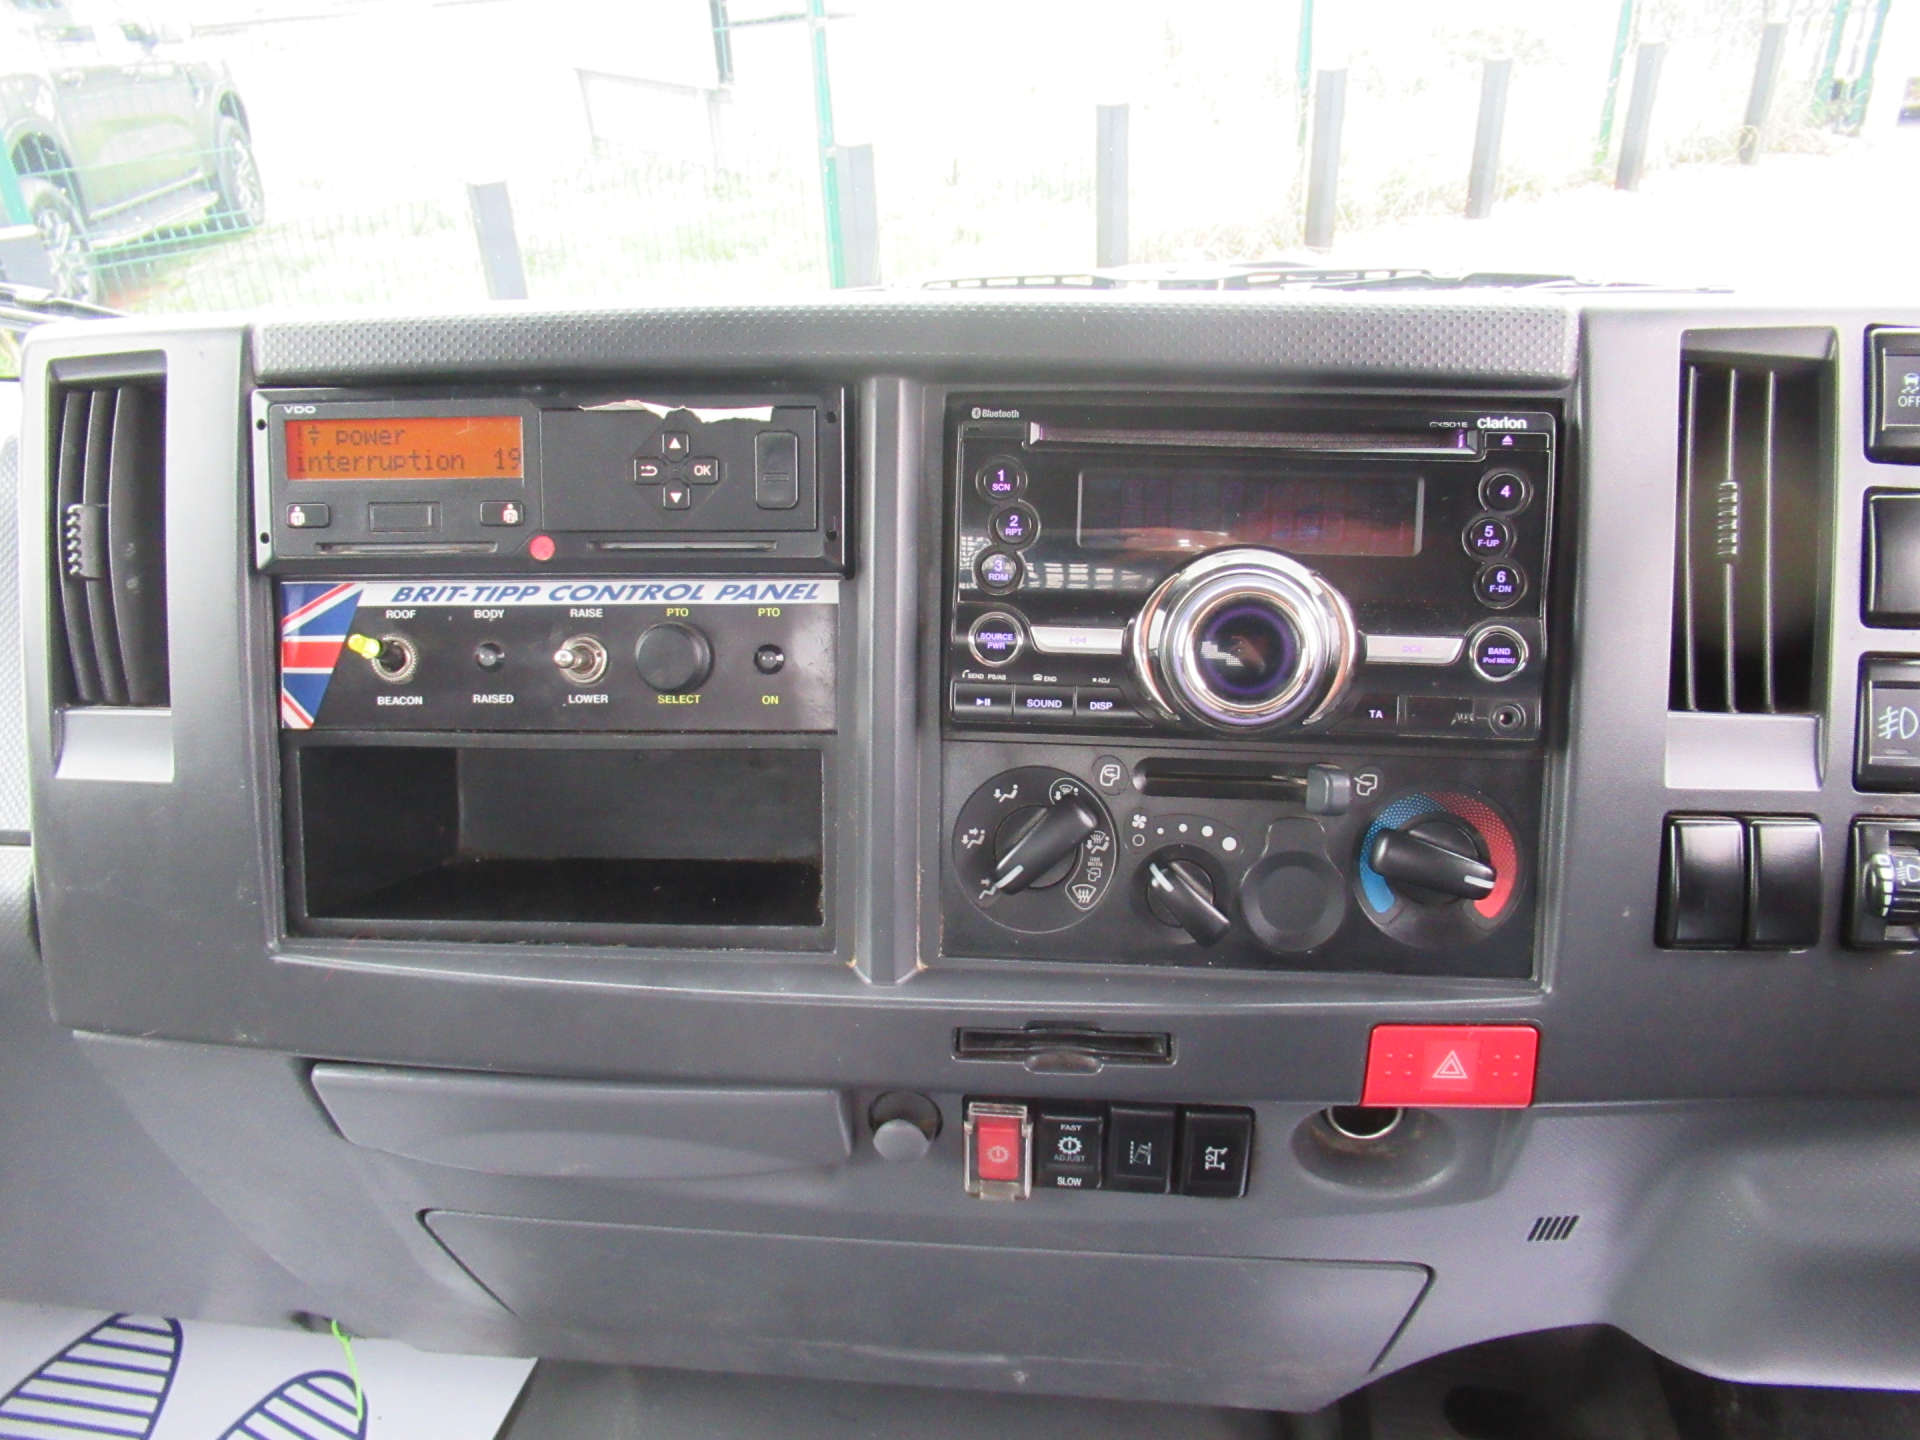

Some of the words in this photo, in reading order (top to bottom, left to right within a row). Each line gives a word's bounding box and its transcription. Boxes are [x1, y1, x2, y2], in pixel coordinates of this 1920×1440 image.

[1898, 395, 1920, 407] OFF
[283, 405, 316, 414] VDO
[981, 409, 1019, 418] Bluetooth
[335, 428, 406, 446] power
[296, 448, 465, 473] interruption
[693, 464, 712, 476] OK
[998, 470, 1005, 481] 1
[992, 483, 1011, 491] SCN
[1500, 485, 1511, 498] 4
[1009, 515, 1018, 526] 2
[1005, 528, 1022, 536] RPT
[1484, 526, 1494, 537] 5
[1477, 539, 1500, 547] F-UP
[995, 560, 1003, 571] 3
[1496, 571, 1506, 583] 6
[391, 585, 541, 602] BRIT-TIPP
[548, 584, 706, 601] CONTROL
[715, 583, 820, 600] PANEL
[385, 609, 416, 619] ROOF
[474, 609, 505, 619] BODY
[570, 608, 603, 618] RAISE
[666, 607, 689, 617] PTO
[758, 607, 781, 617] PTO
[980, 632, 1013, 641] SOURCE
[1487, 647, 1511, 655] BAND
[377, 696, 423, 705] BEACON
[472, 694, 514, 704] RAISED
[568, 694, 608, 704] LOWER
[657, 695, 700, 704] SELECT
[762, 695, 779, 705] ON
[1026, 698, 1063, 708] SOUND
[1090, 701, 1113, 710] DISP
[1369, 709, 1383, 719] TA
[1057, 1176, 1082, 1186] SLOW
